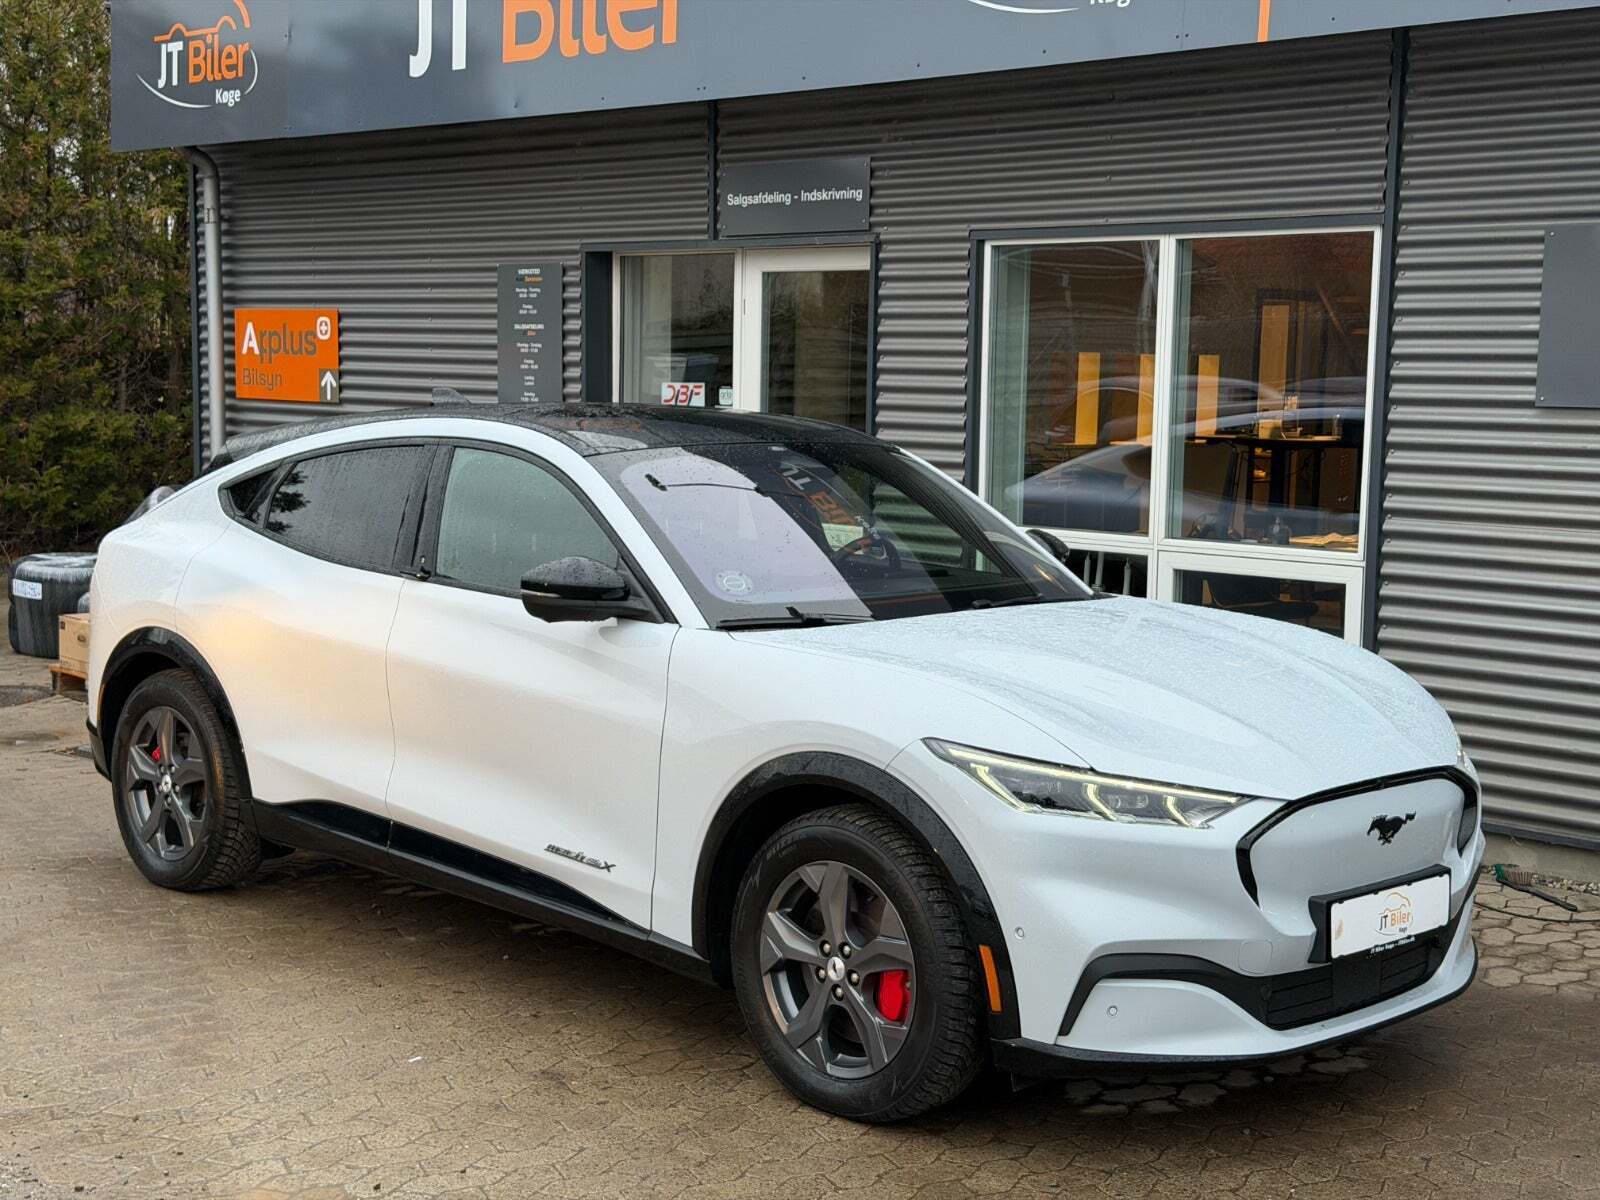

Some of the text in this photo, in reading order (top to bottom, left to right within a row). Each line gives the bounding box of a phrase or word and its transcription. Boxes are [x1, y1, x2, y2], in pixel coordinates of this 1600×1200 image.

[158, 33, 250, 88] JT Biler
[215, 88, 241, 107] Køge
[727, 191, 791, 208] Salgsafdeling
[800, 187, 863, 202] Indskrivning
[242, 368, 283, 391] Bilsyn
[1379, 910, 1410, 930] JT Biler
